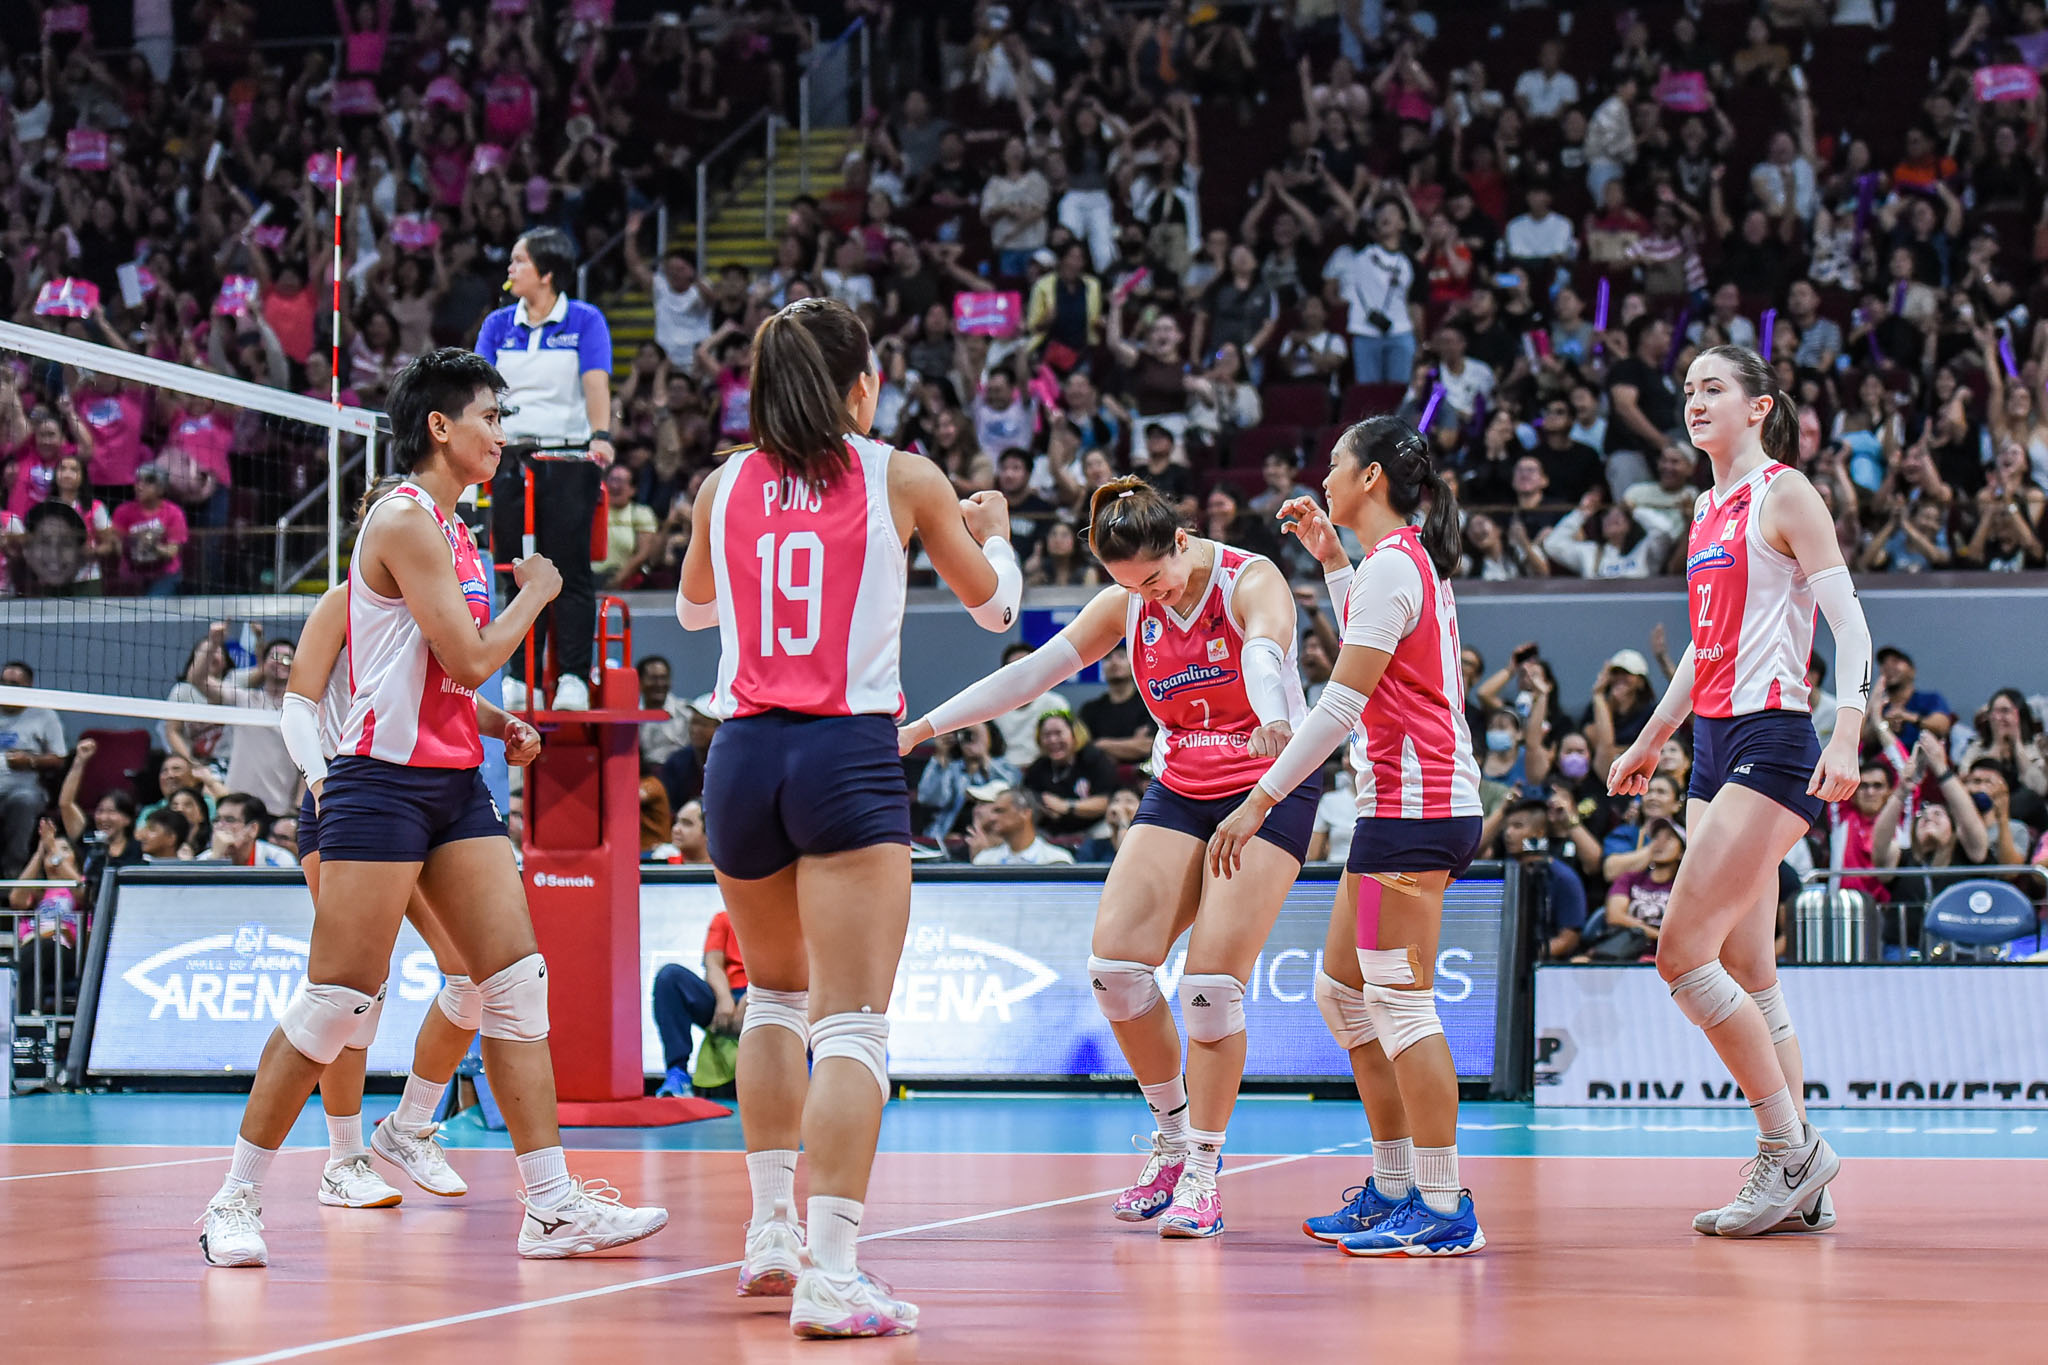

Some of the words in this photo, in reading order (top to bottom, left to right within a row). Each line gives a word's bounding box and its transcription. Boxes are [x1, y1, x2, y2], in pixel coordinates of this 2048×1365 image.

[763, 476, 827, 517] PONS
[756, 531, 824, 657] 19
[1697, 584, 1713, 628] 22
[1149, 665, 1221, 701] Creamline
[1190, 698, 1210, 730] 7
[1178, 732, 1229, 749] Allianz
[545, 873, 595, 888] Senoh
[889, 973, 1013, 1023] ENA
